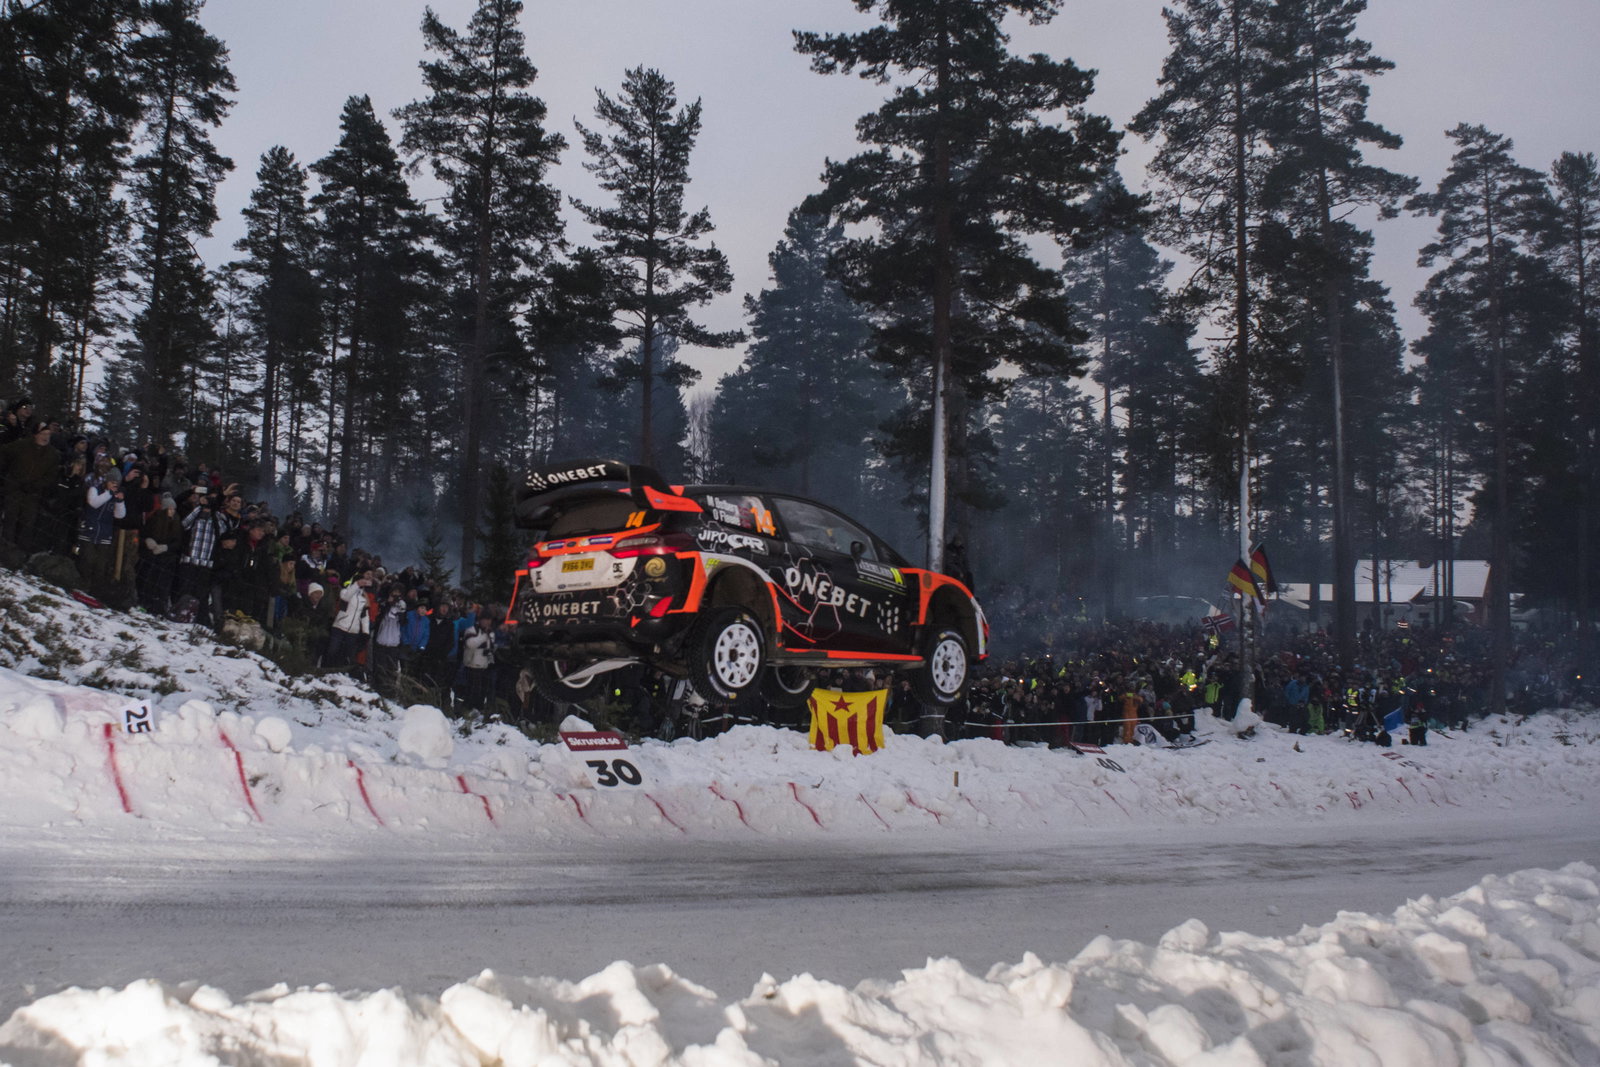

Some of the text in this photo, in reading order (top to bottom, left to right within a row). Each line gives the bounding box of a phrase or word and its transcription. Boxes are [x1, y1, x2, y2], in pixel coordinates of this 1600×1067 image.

[548, 464, 607, 485] ONEBET
[625, 511, 647, 528] 14
[751, 506, 776, 536] 14
[785, 567, 871, 617] ONEBET
[543, 601, 600, 617] ONEBET
[126, 705, 151, 734] 25
[585, 758, 642, 787] 30
